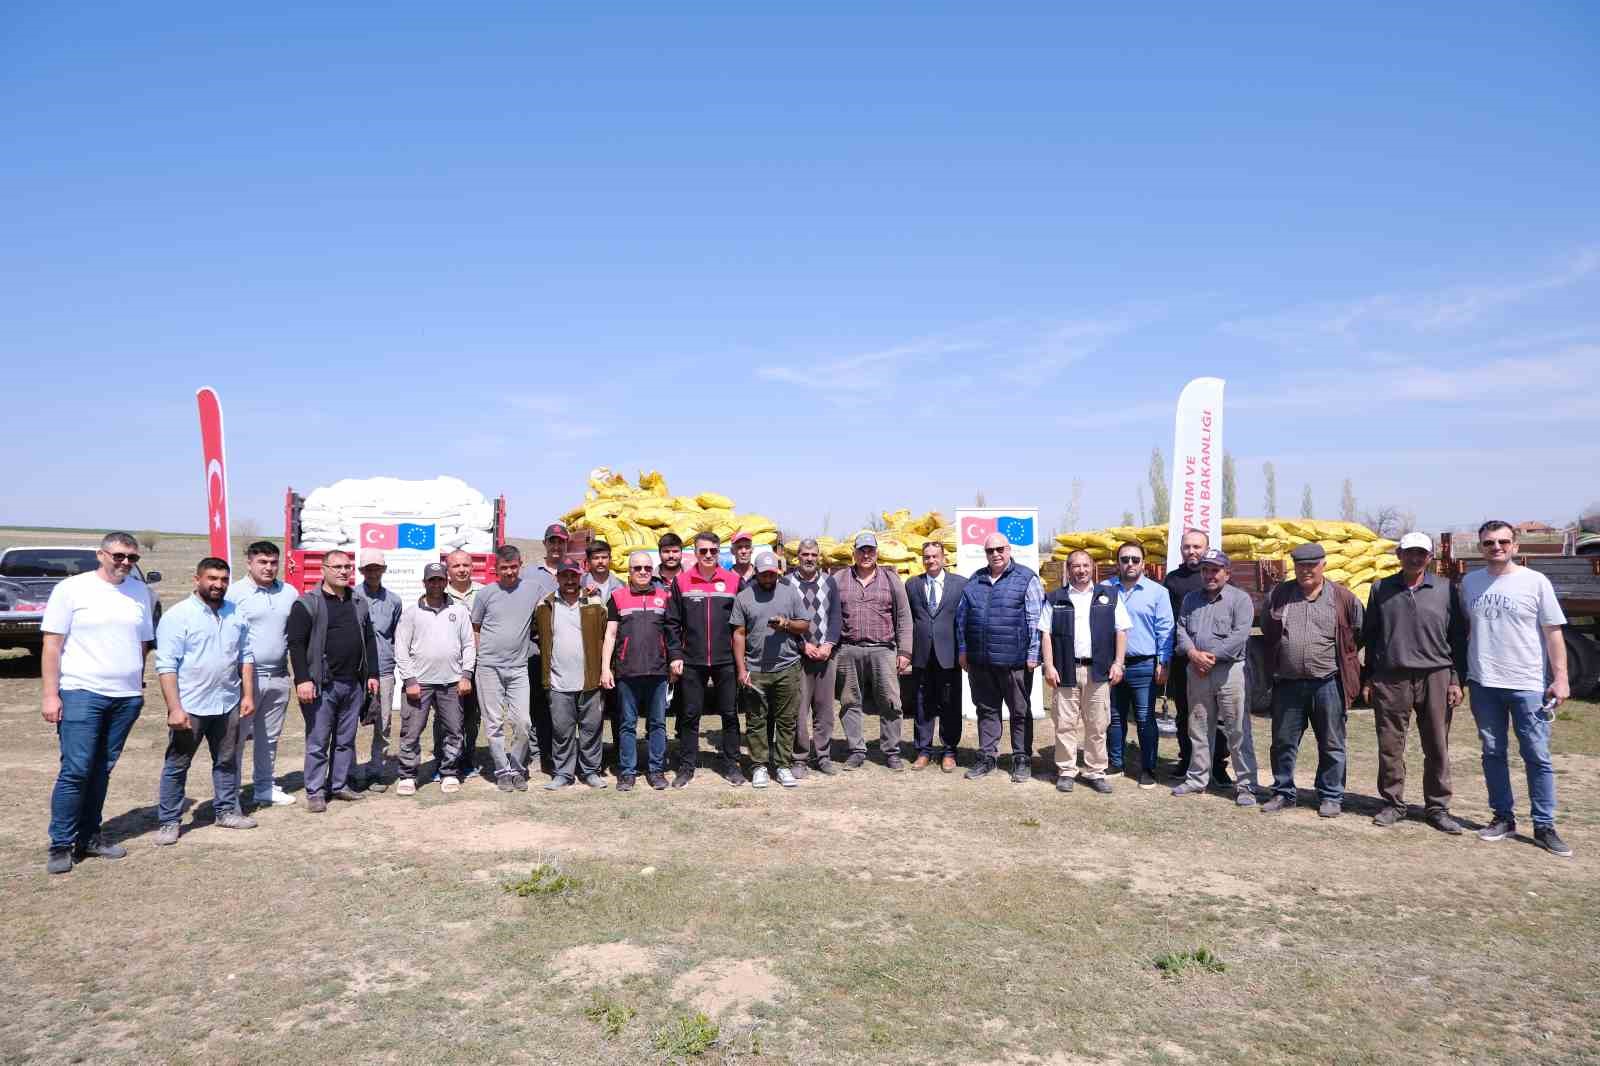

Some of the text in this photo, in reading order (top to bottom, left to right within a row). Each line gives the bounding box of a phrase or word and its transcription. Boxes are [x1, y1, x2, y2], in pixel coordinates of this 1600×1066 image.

[1183, 455, 1196, 533] TARIM VE
[1200, 504, 1210, 533] AN
